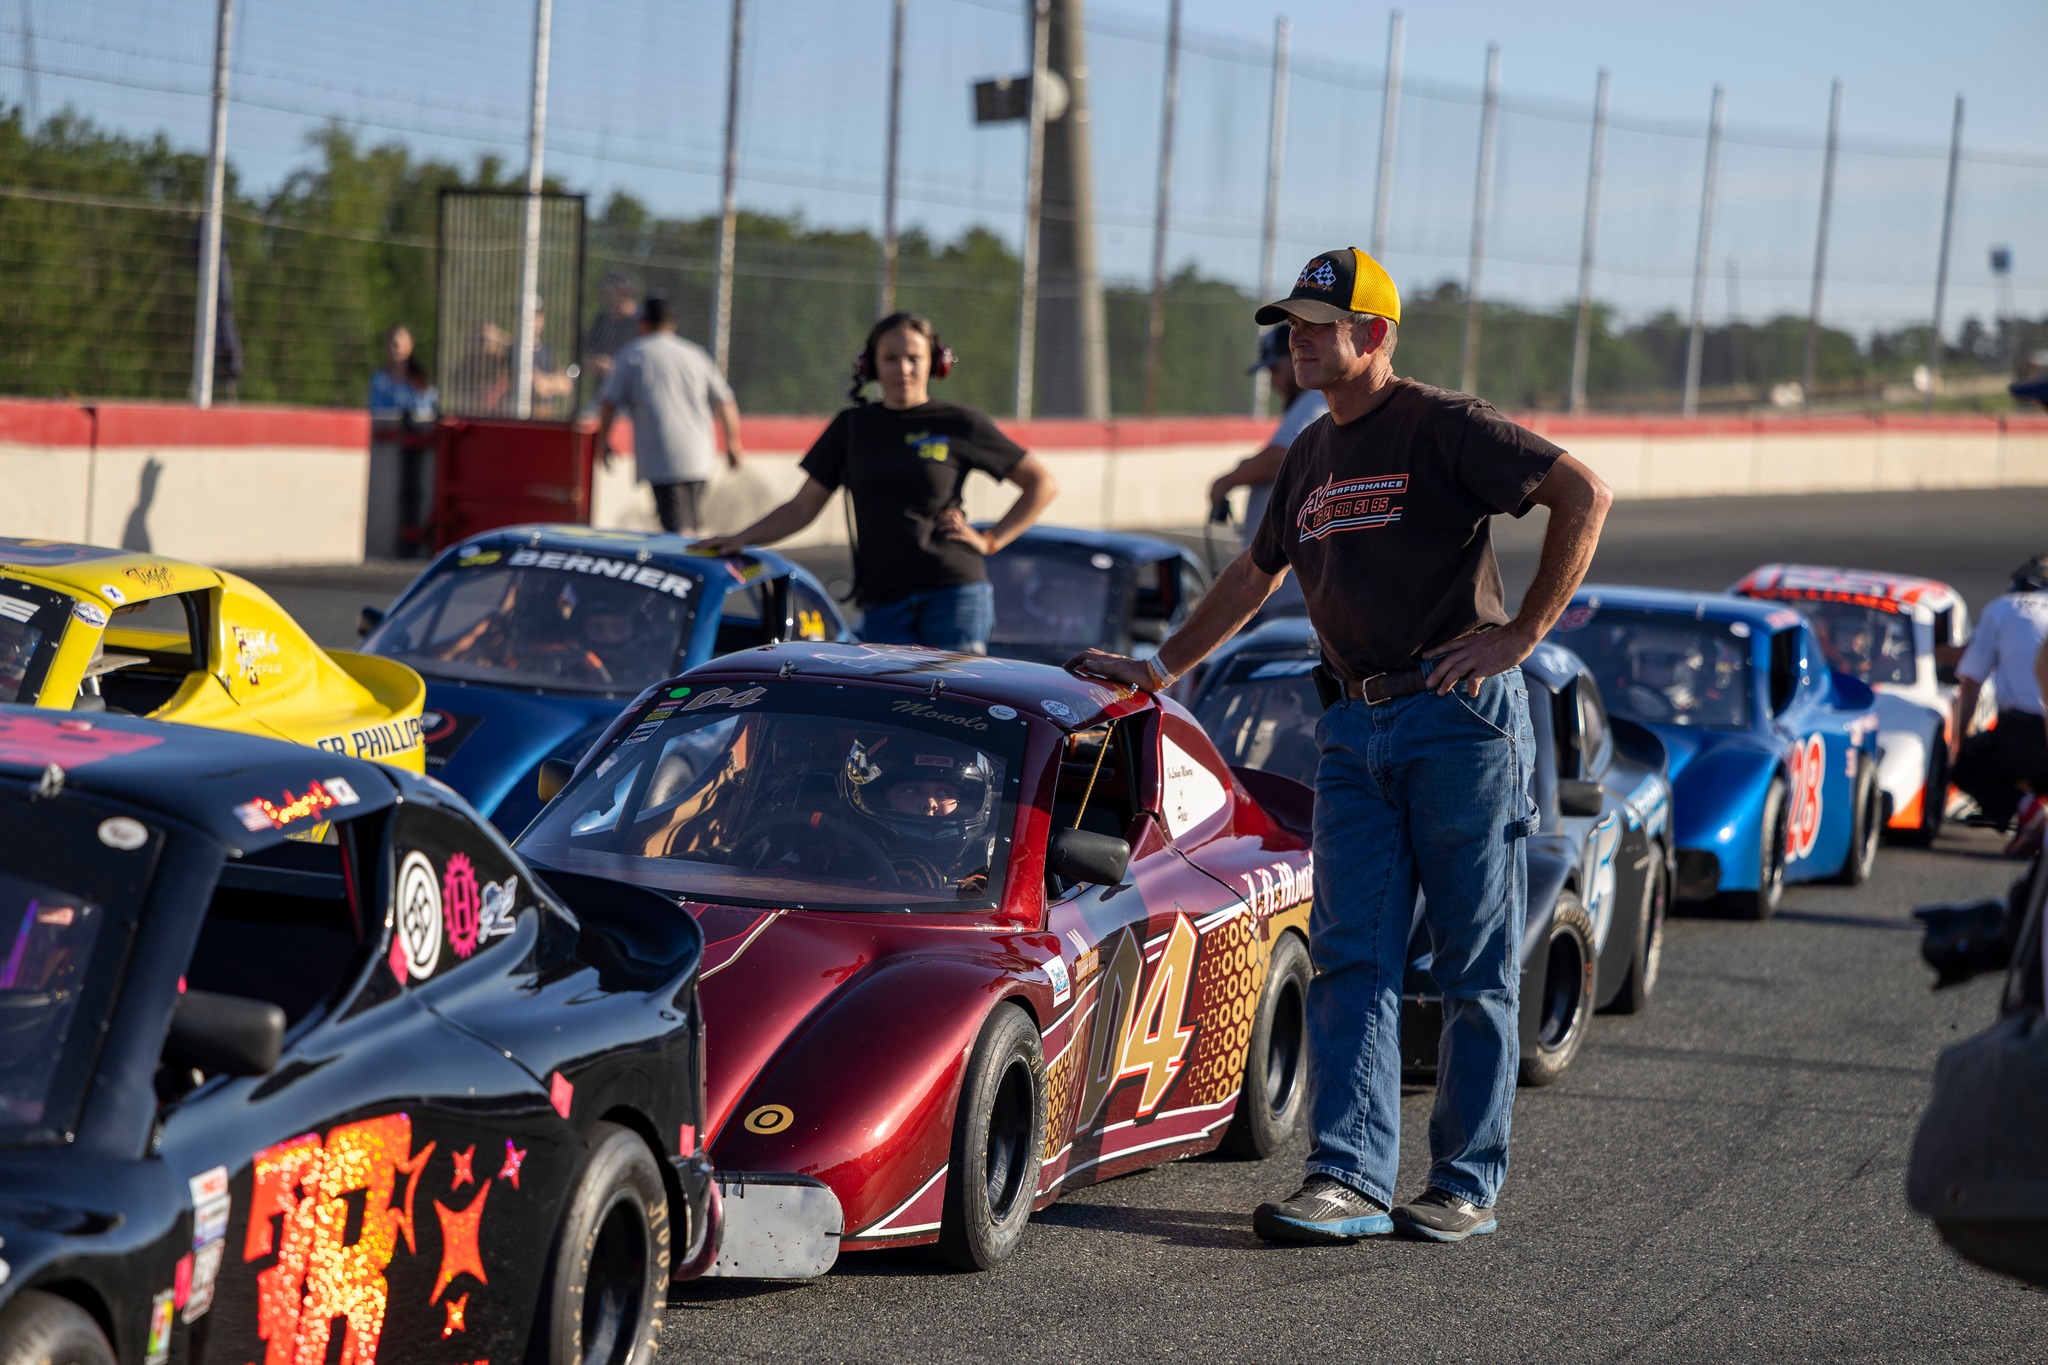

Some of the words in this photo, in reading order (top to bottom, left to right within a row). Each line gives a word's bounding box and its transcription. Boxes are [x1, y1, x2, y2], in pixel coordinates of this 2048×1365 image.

[1326, 480, 1403, 498] PERFORMANCE
[1353, 499, 1370, 514] 51
[1371, 497, 1390, 512] 95
[508, 549, 693, 599] BERNIER
[680, 687, 768, 711] 04
[351, 718, 424, 760] PHILLIP
[917, 755, 952, 767] SIMPSON
[1075, 904, 1199, 1134] 04
